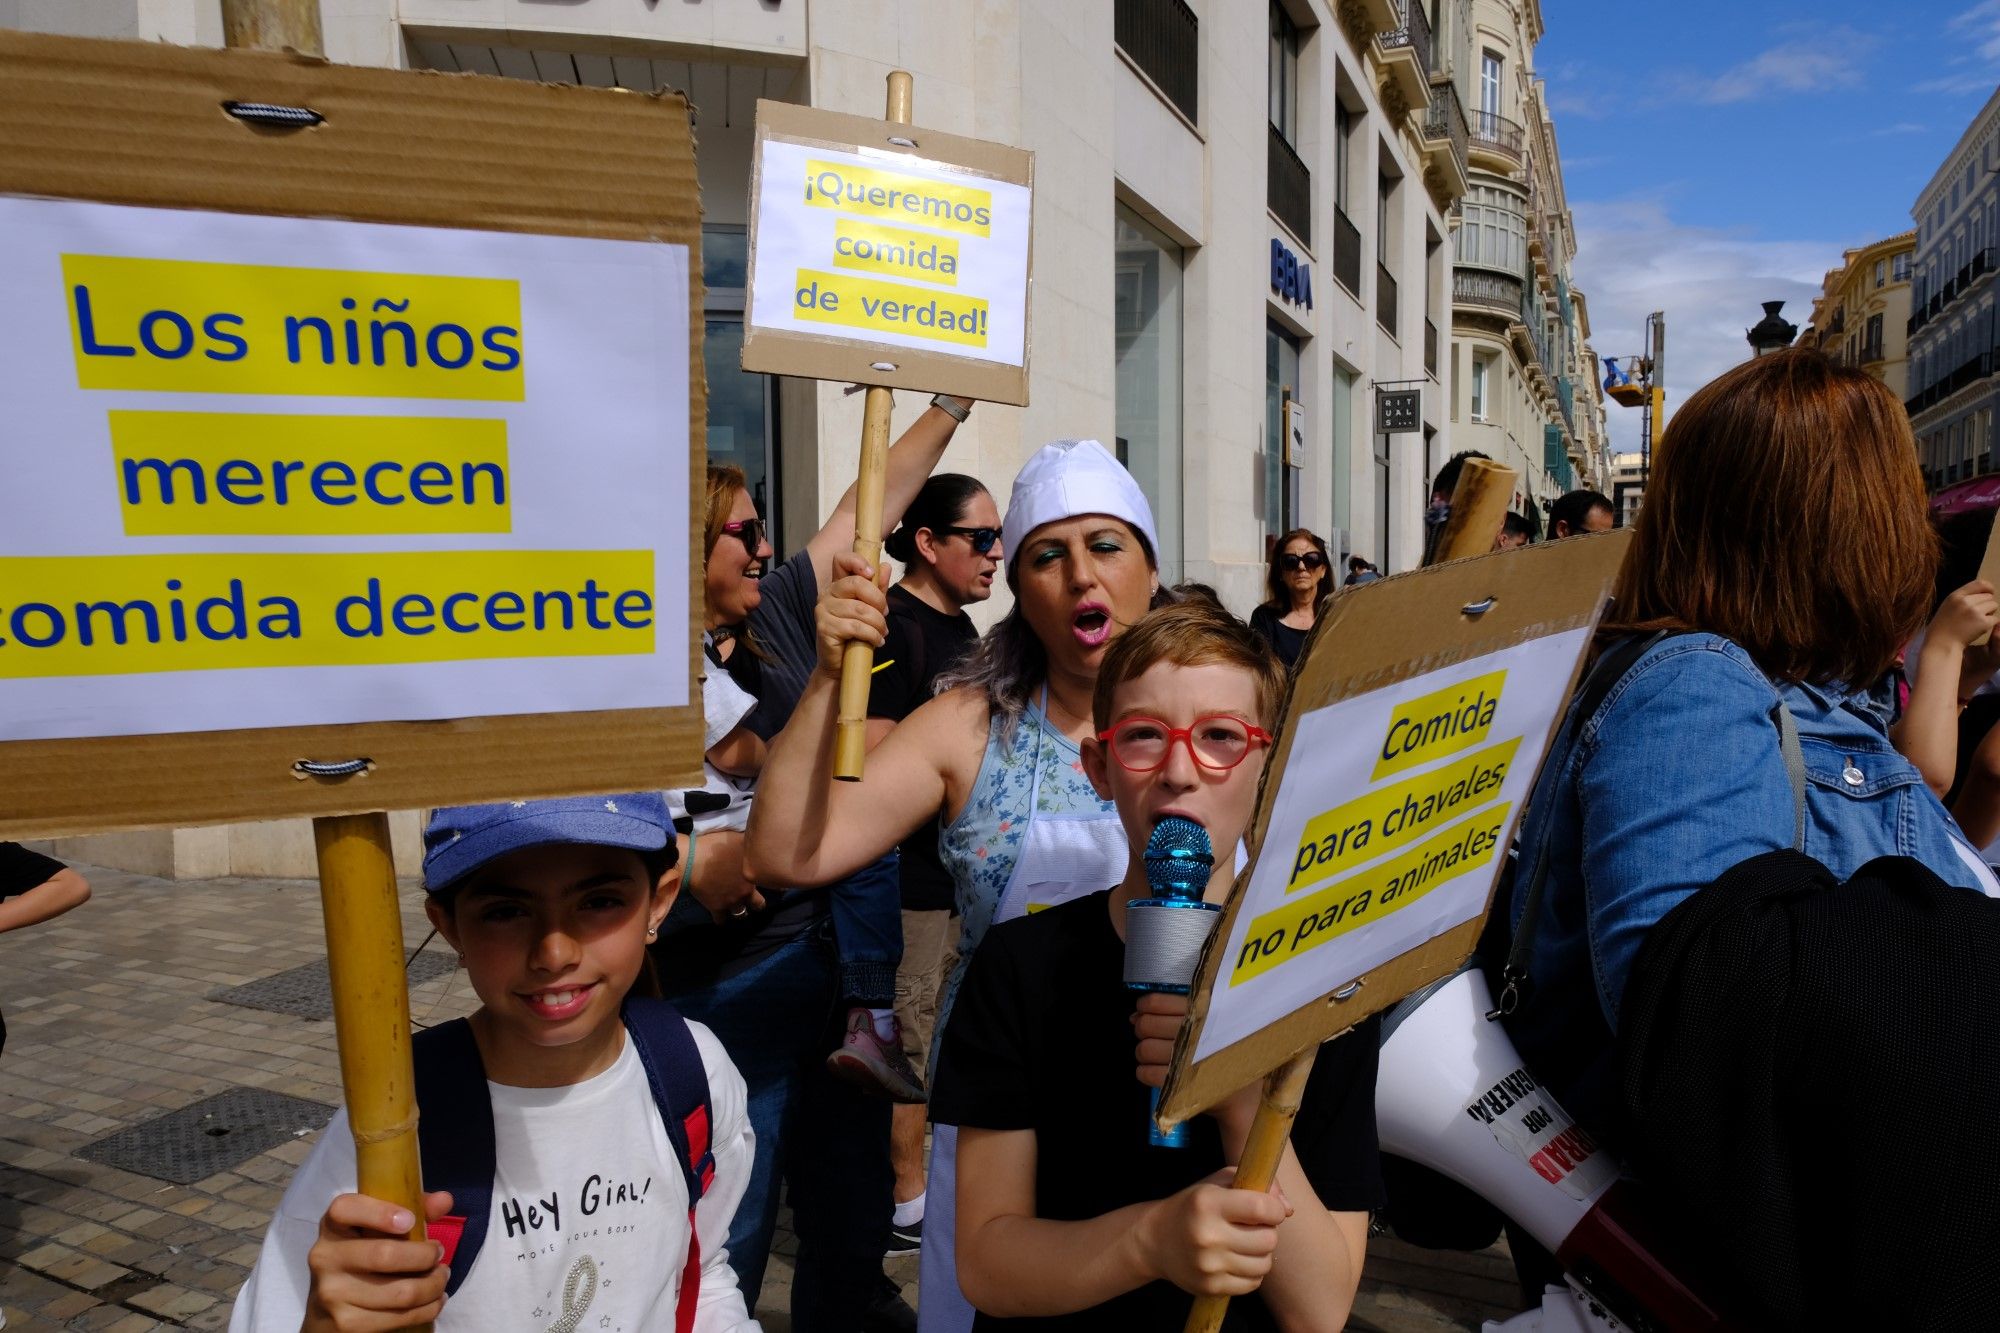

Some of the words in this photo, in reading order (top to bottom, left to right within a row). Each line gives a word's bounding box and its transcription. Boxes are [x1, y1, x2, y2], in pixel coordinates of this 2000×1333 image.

[805, 171, 991, 226] ¡Queremos
[835, 236, 956, 275] comida
[1270, 237, 1314, 311] BBVA
[74, 284, 248, 363] Los
[285, 297, 522, 372] niños
[796, 281, 839, 312] de
[861, 295, 987, 336] verdad!
[121, 456, 507, 506] merecen
[334, 577, 654, 639] decente
[1381, 690, 1497, 761] Comida
[1288, 818, 1373, 885] para
[1381, 761, 1506, 837] chavales,
[1236, 927, 1286, 970] no
[1290, 888, 1373, 952] para
[1378, 823, 1502, 906] animales
[1520, 1105, 1554, 1135] POR
[517, 1244, 555, 1261] MOVE
[567, 1229, 599, 1245] YOUR
[607, 1224, 635, 1235] BODY
